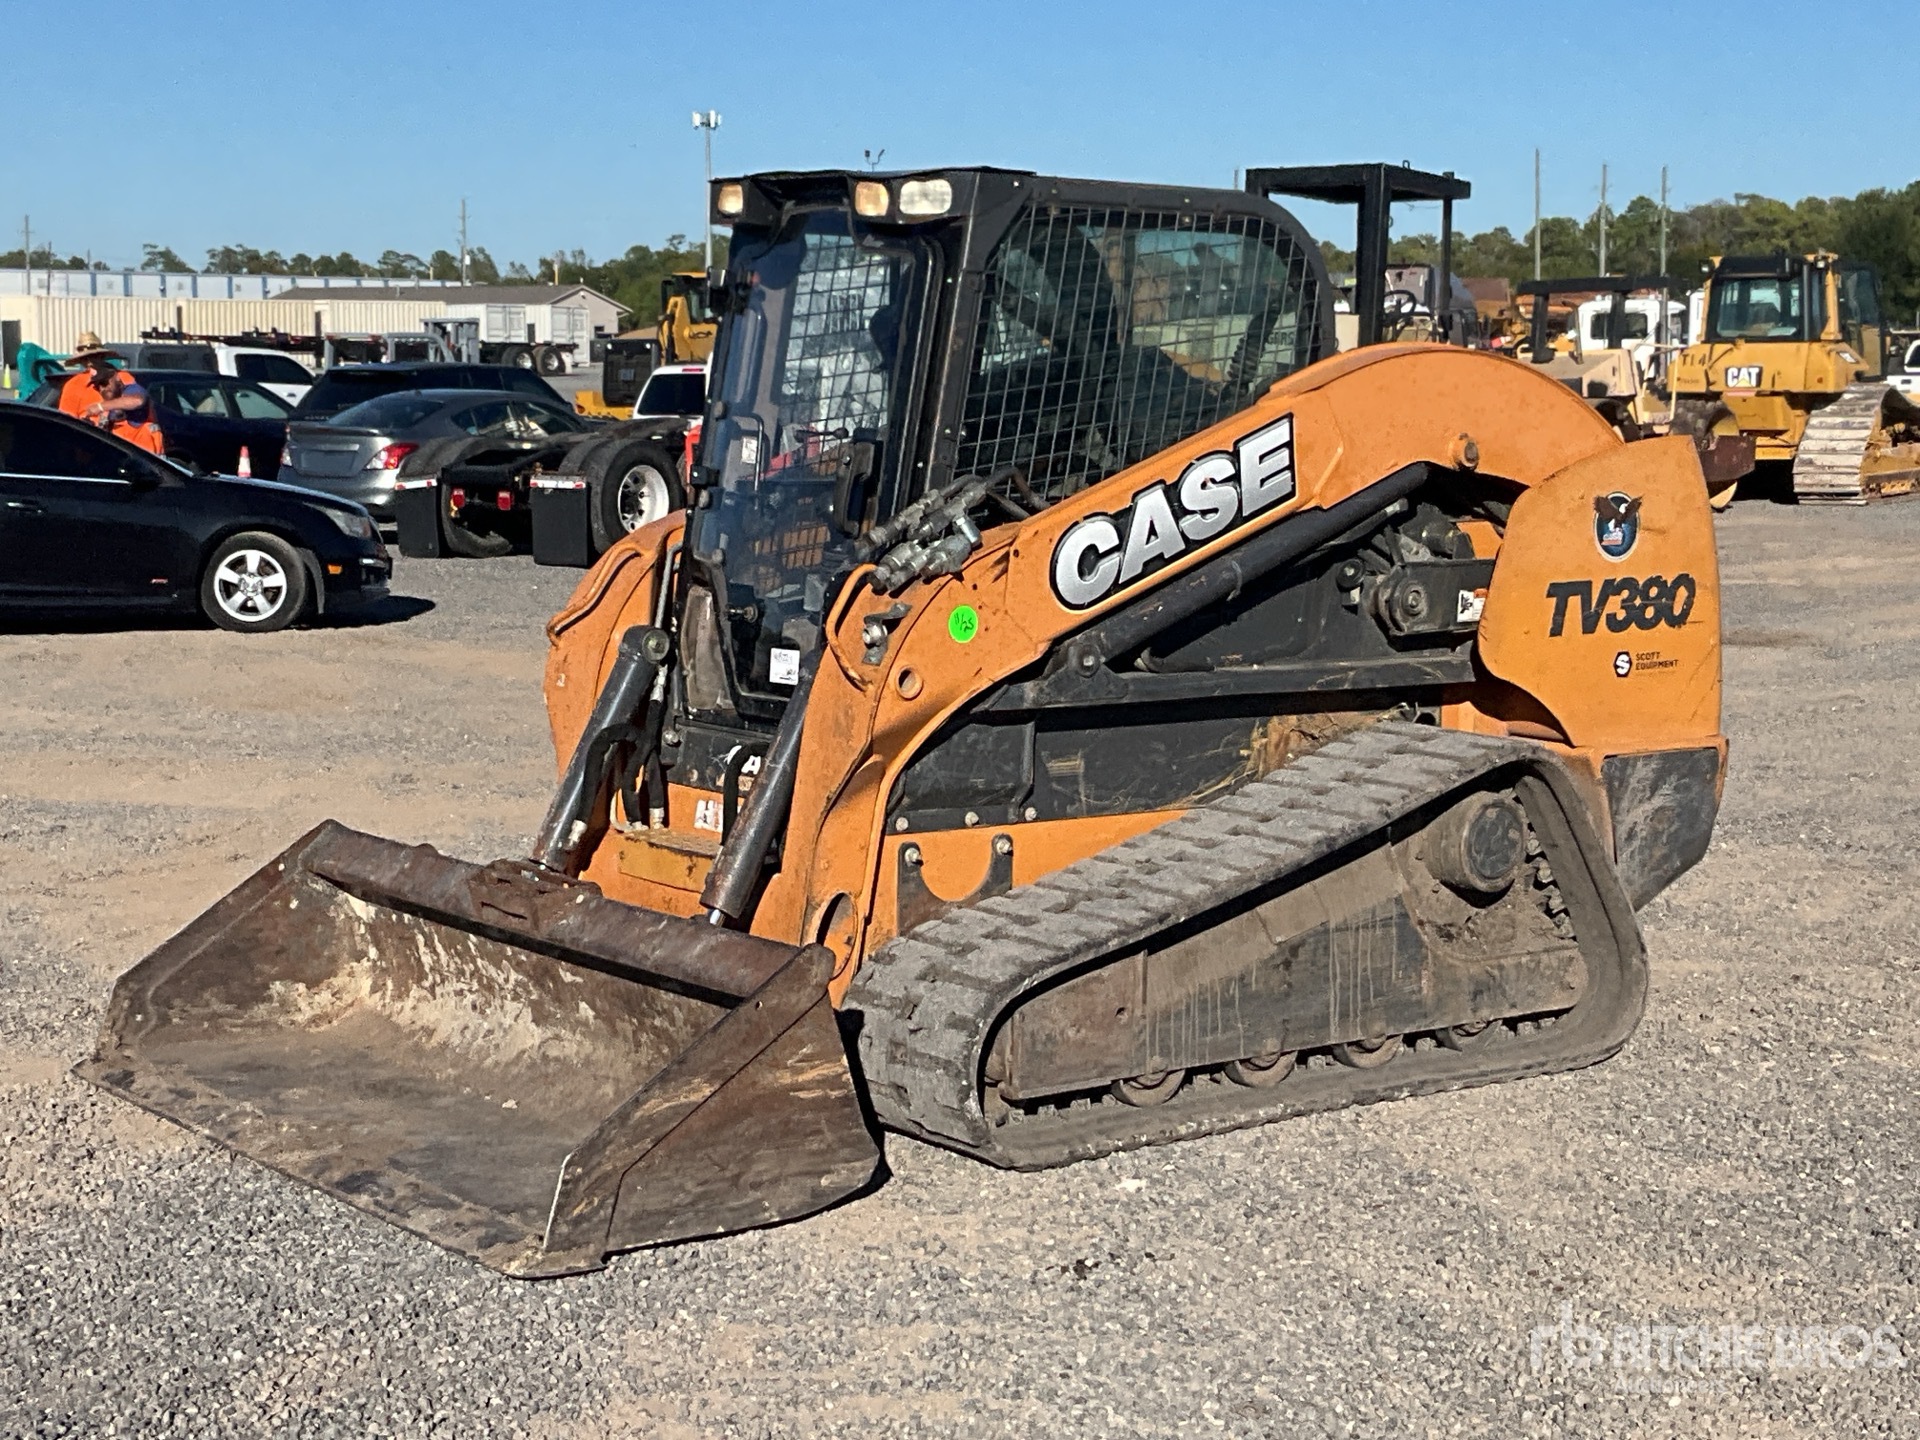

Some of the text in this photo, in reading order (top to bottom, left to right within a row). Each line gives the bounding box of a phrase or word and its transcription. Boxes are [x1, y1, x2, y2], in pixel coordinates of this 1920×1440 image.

[1727, 367, 1760, 388] CAT
[1052, 416, 1294, 606] CASE
[1546, 573, 1696, 637] TV380
[1635, 651, 1660, 661] SCOTT
[1635, 659, 1679, 671] EQUIPMENT
